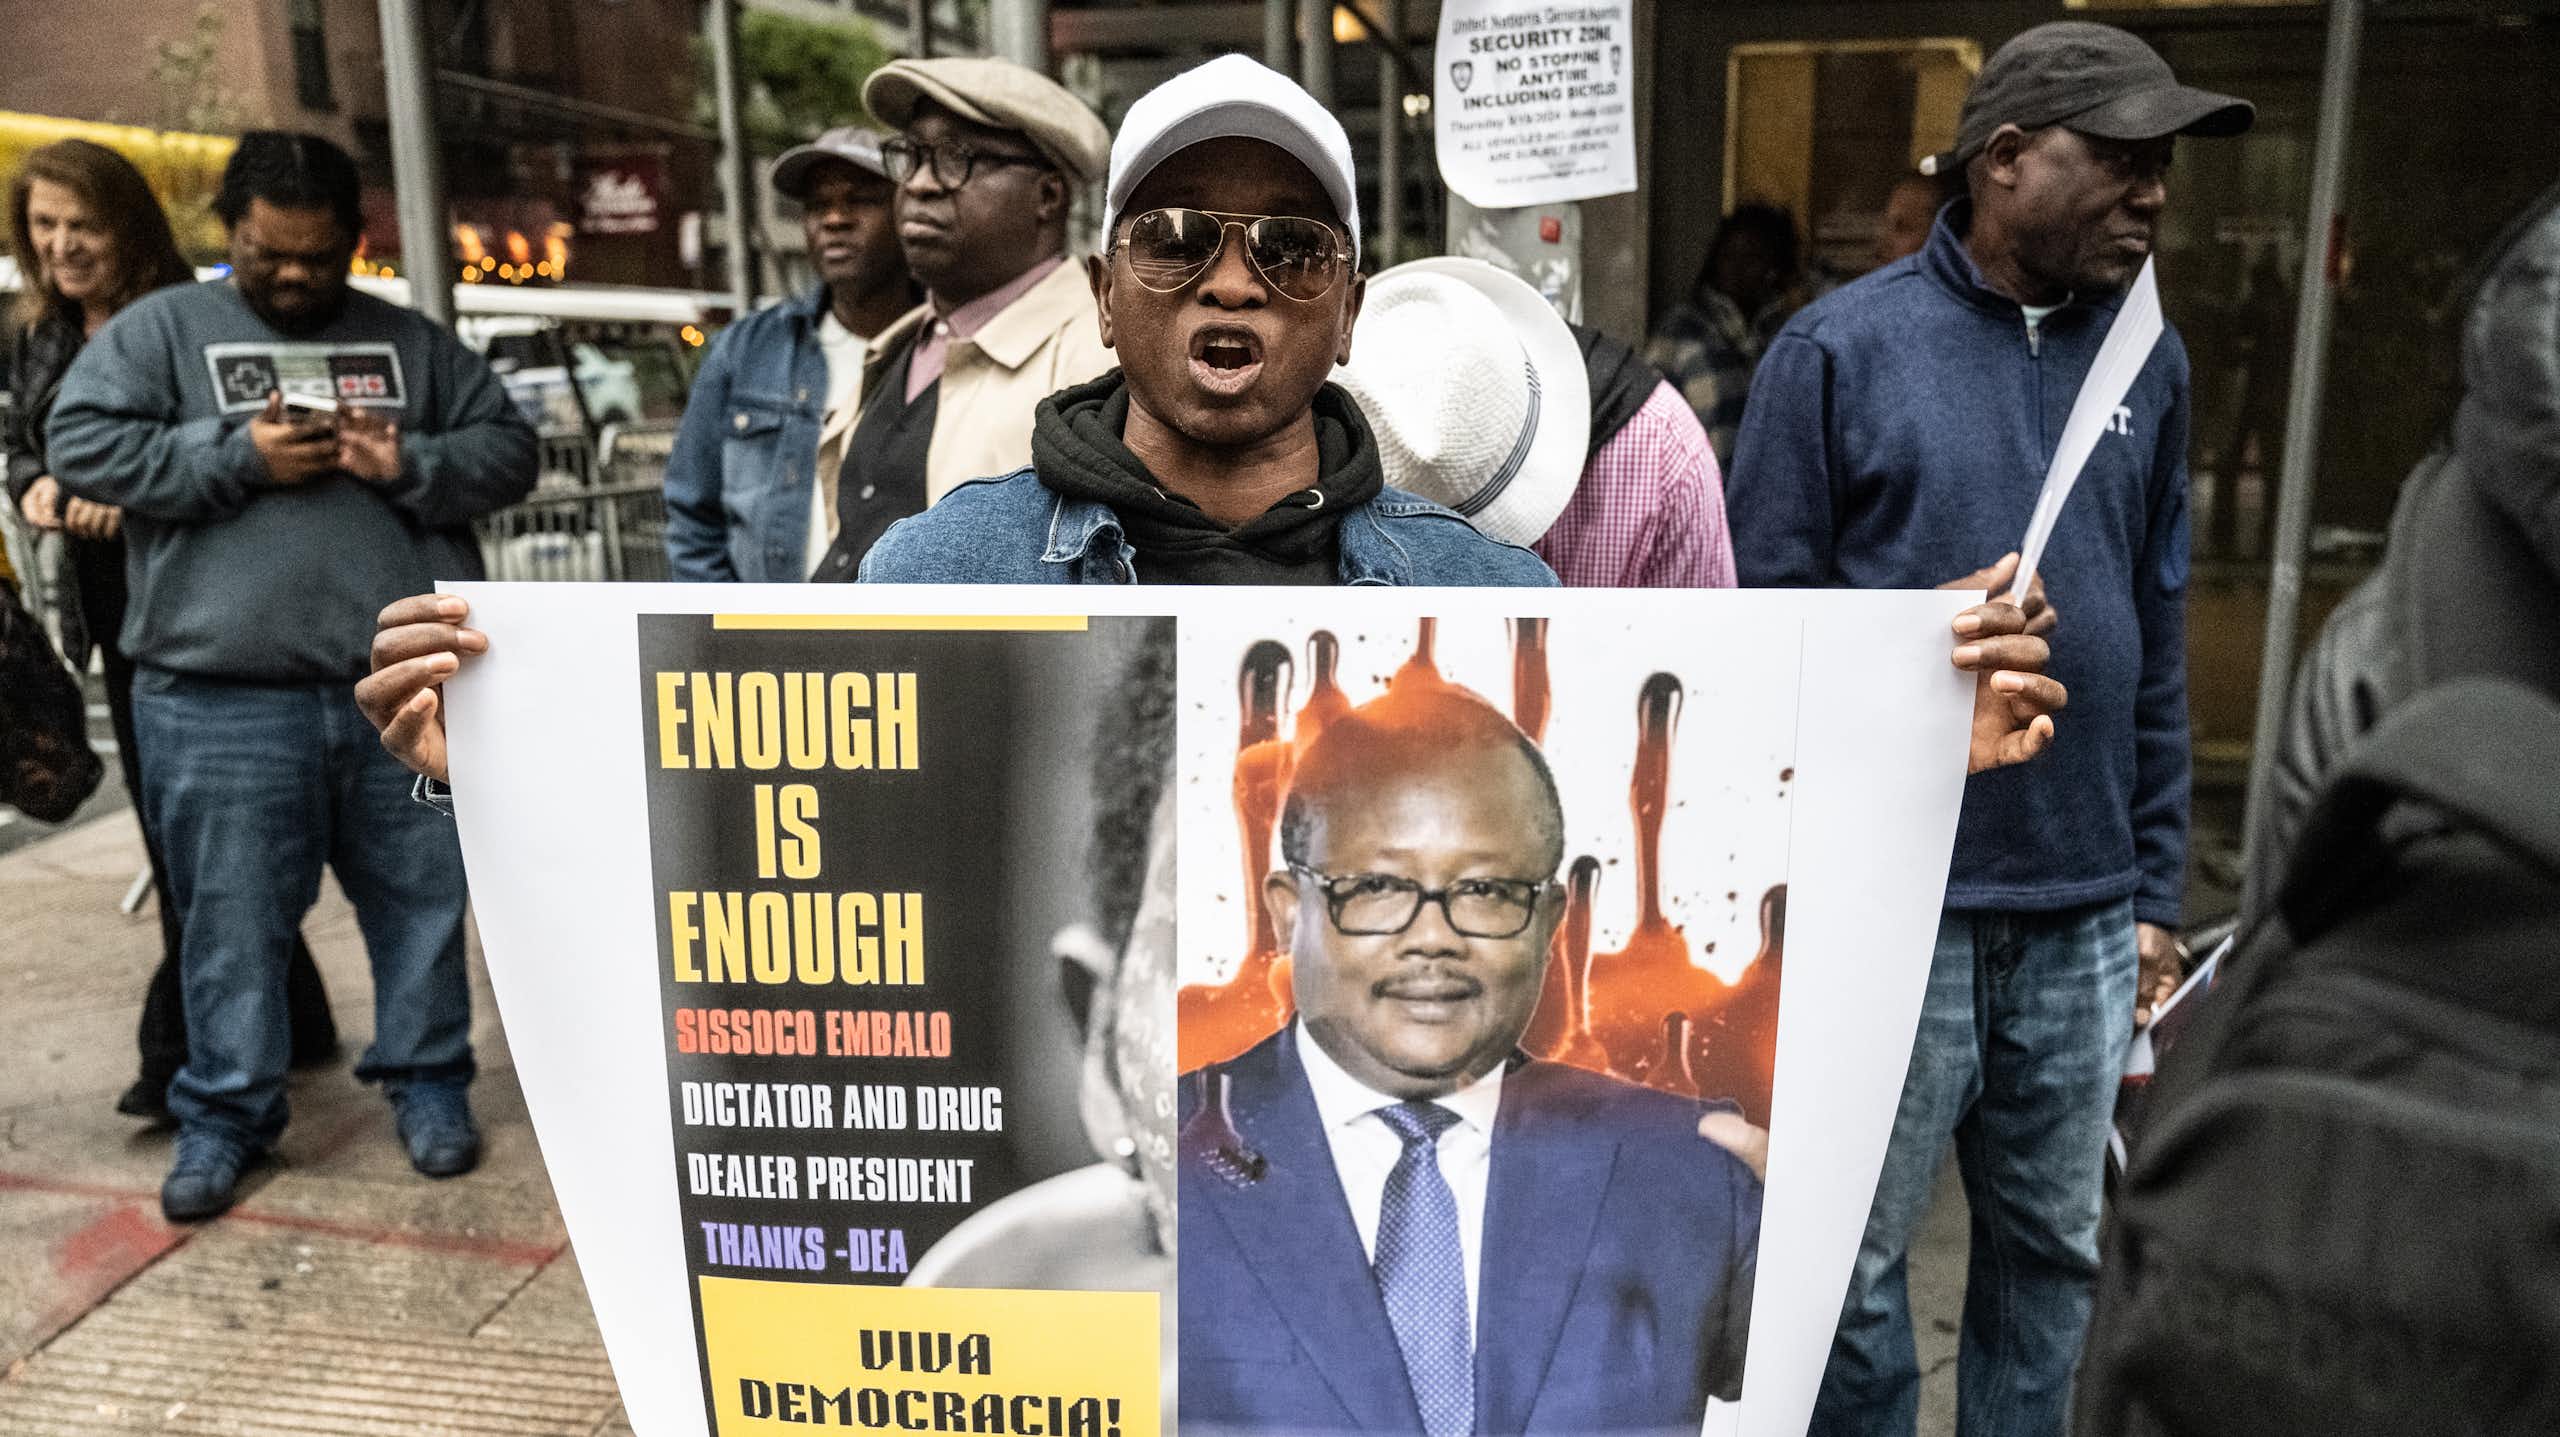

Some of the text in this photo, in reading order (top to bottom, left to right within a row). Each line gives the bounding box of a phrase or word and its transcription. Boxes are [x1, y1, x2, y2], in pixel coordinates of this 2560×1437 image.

[1470, 25, 1611, 53] SECURITY ZONE
[1496, 56, 1521, 72] NO
[1520, 69, 1587, 86] ANYTIME
[1464, 88, 1562, 110] INCLUDING
[656, 671, 920, 770] ENOUGH
[754, 783, 822, 879] IS
[669, 891, 925, 985] ENOUGH
[675, 1008, 951, 1057] SISSOCO EMBALO
[681, 1081, 1002, 1132] DICTATOR AND DRUG
[688, 1153, 974, 1203] DEALER PRESIDENT
[701, 1222, 825, 1271] THANKS
[859, 1329, 992, 1376] VIVA
[739, 1378, 1122, 1437] DEMOCRACIA!
